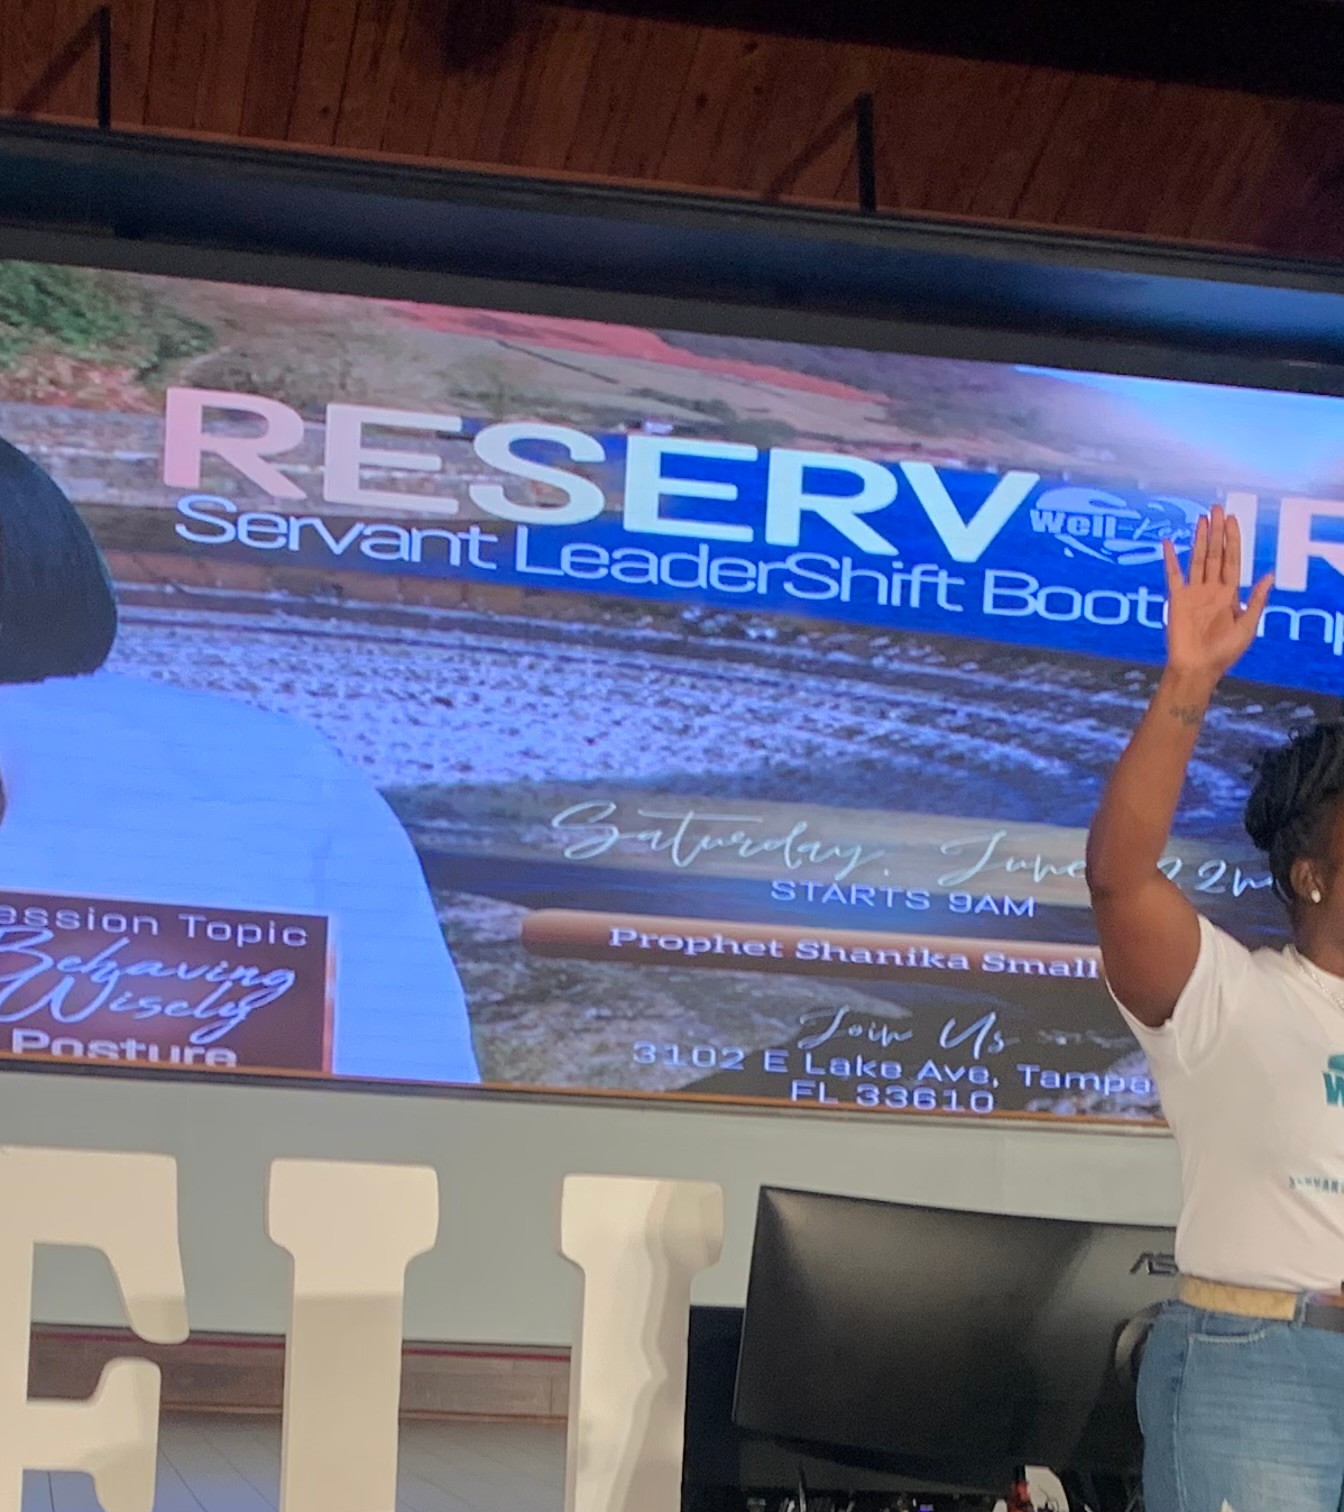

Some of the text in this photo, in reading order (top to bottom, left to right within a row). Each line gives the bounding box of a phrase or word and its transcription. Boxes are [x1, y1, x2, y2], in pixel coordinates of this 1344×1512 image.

[175, 494, 498, 570] Servant
[516, 524, 965, 611] LeaderShift
[938, 830, 1087, 888] June
[771, 877, 1036, 918] STARTS 9AM
[178, 912, 309, 948] Topic
[609, 926, 1100, 981] Prophet Shanika Small
[12, 1026, 239, 1068] Posture
[798, 1003, 1020, 1060] Join Us
[632, 1040, 745, 1071] 3102
[763, 1050, 789, 1073] E
[805, 1051, 902, 1081] Lake
[1016, 1063, 1151, 1097] Tampa
[791, 1079, 994, 1114] FL 33610
